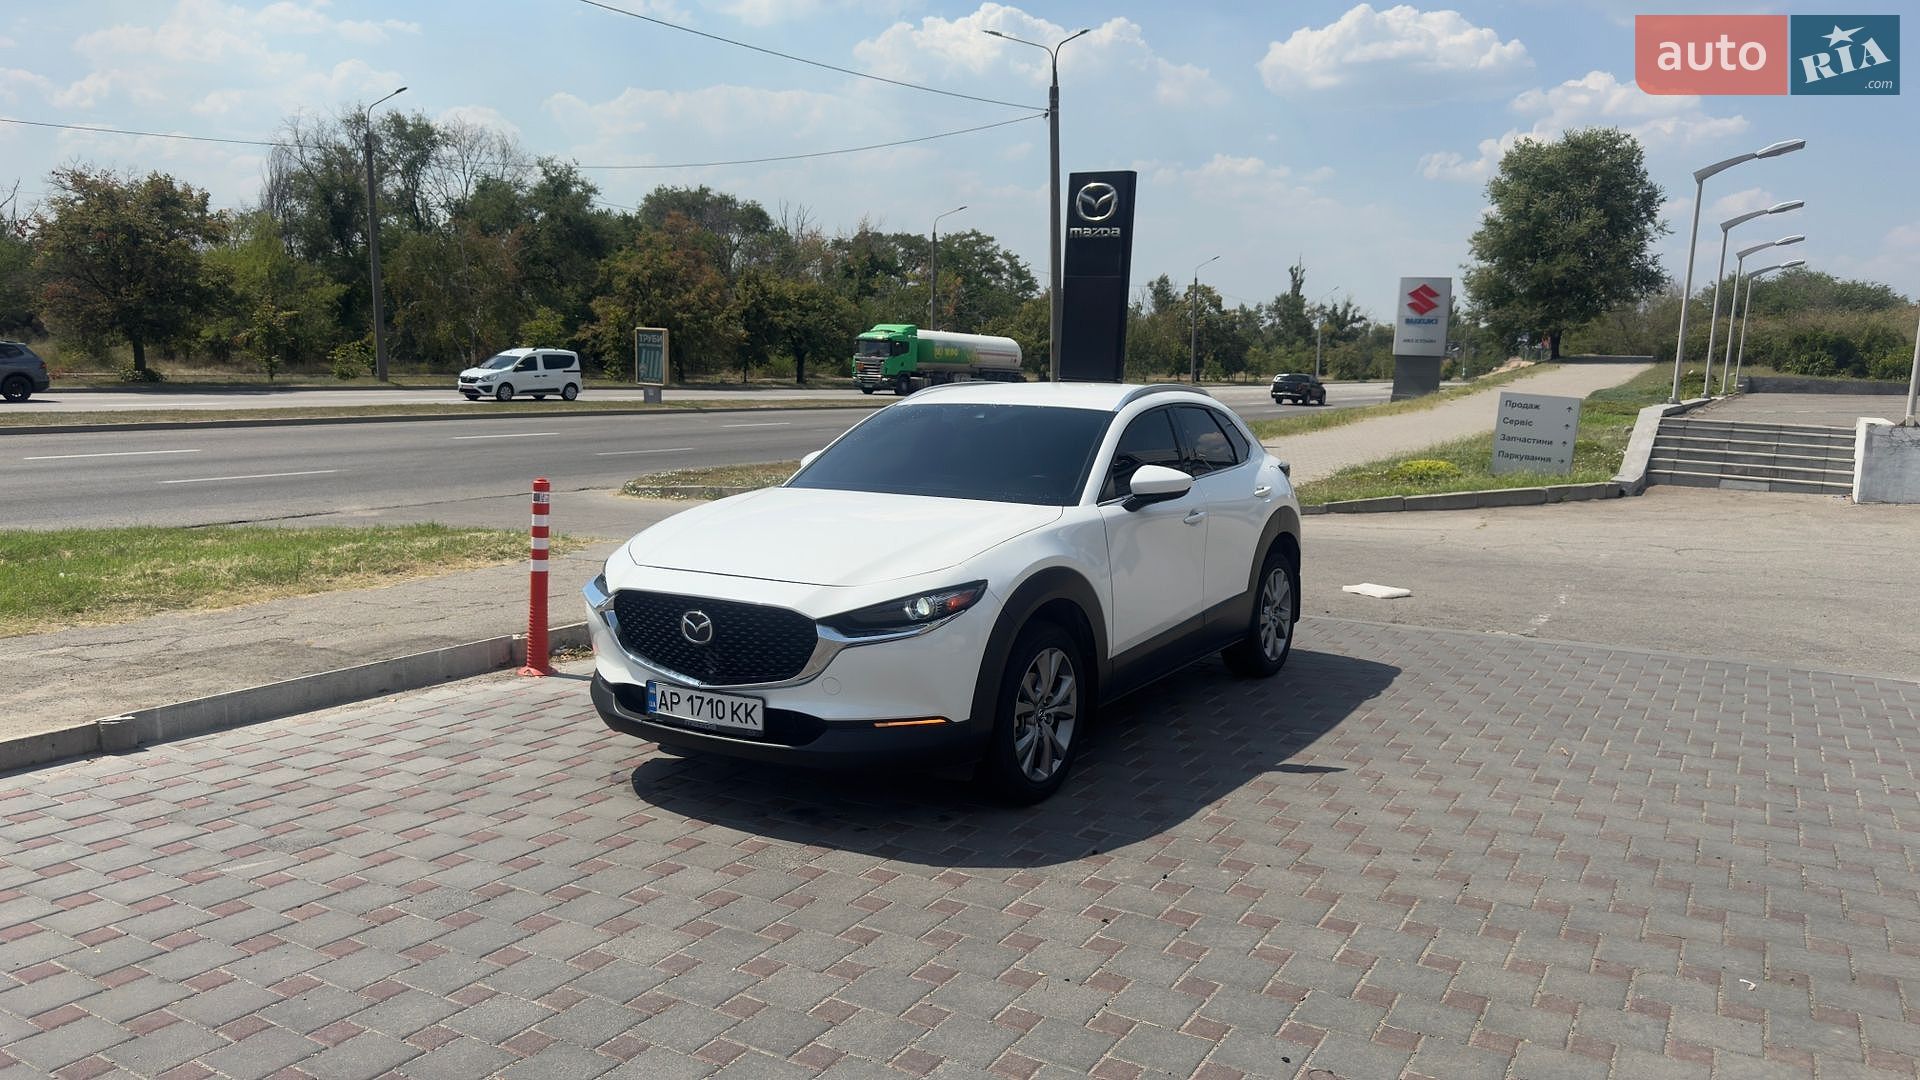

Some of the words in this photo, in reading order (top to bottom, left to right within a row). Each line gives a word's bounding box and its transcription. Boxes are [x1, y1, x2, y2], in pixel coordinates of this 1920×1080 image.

[1504, 399, 1541, 410] Продаж
[1502, 416, 1534, 427] Сервіс
[1499, 433, 1554, 446] Запчастини
[1497, 450, 1552, 463] Паркування
[658, 690, 681, 712] AP
[686, 694, 726, 720] 1710
[730, 701, 758, 726] KK
